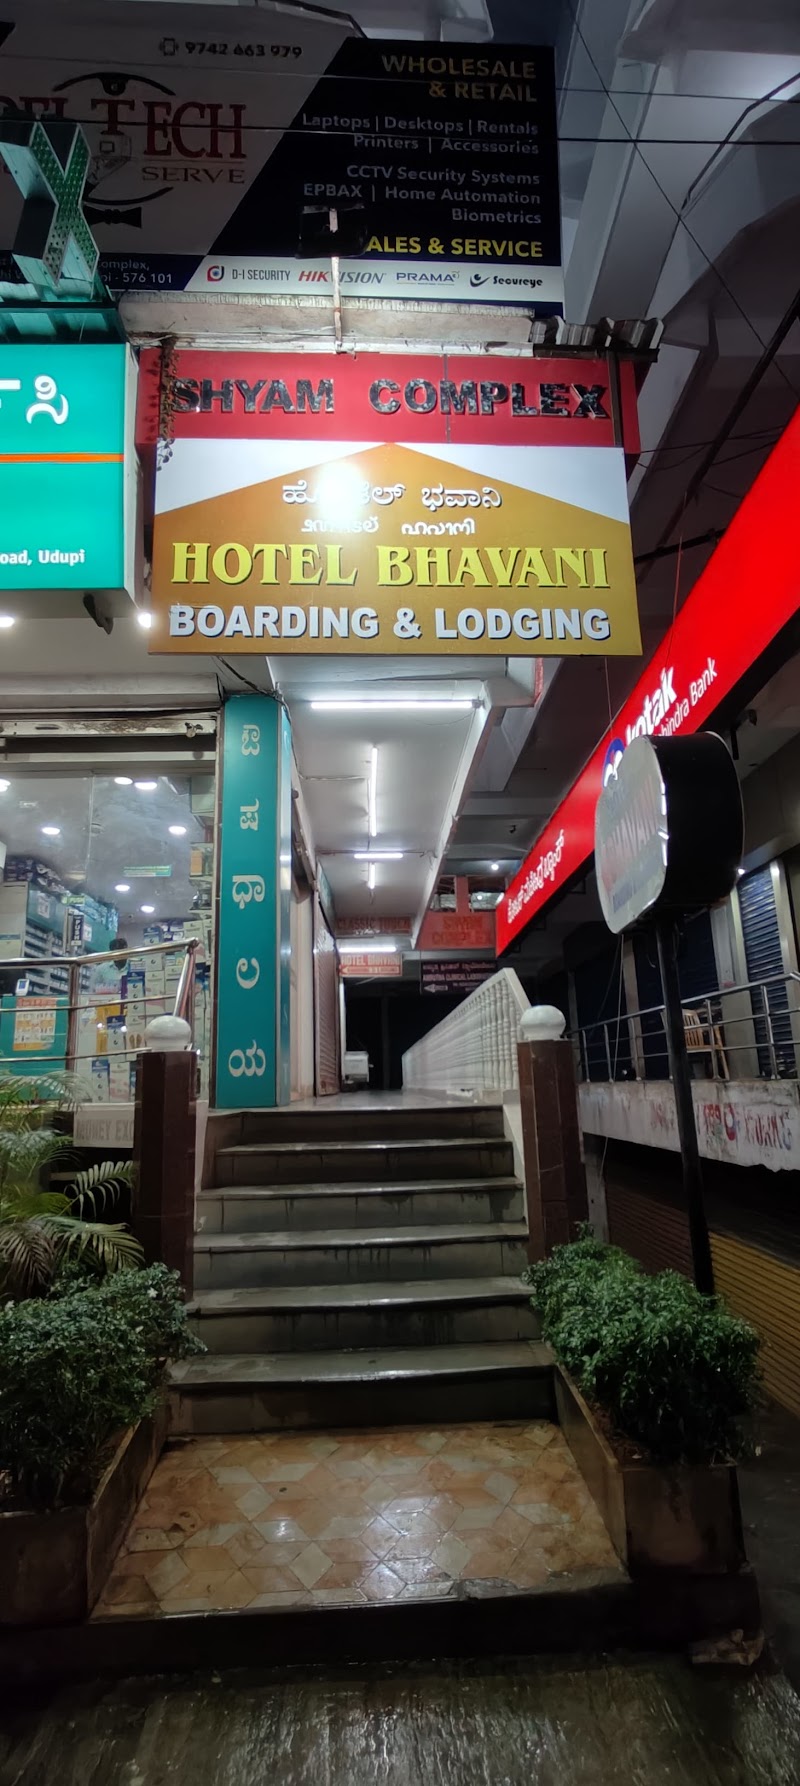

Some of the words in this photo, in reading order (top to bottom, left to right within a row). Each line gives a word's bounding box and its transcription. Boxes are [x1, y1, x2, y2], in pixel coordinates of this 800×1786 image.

[185, 42, 228, 55] 9742
[234, 44, 265, 57] 663
[271, 45, 302, 59] 979
[382, 54, 537, 79] WHOLESALE
[428, 81, 447, 98] &
[454, 83, 538, 103] RETAIL
[91, 98, 247, 159] TECH
[301, 114, 371, 134] Laptops
[384, 115, 464, 135] Desktops
[477, 119, 539, 136] Rentals
[353, 133, 420, 150] Printers
[440, 139, 540, 155] Accessories
[142, 166, 246, 184] SERVE
[346, 164, 394, 179] CCTV
[396, 166, 466, 186] Security
[471, 169, 541, 186] Systems
[303, 182, 363, 198] EPBAX
[385, 185, 437, 201] Home
[440, 187, 542, 206] Automation
[451, 208, 542, 225] Biometrics
[366, 235, 422, 254] ALES
[427, 236, 445, 255] &
[450, 237, 544, 258] SERVICE
[99, 259, 150, 271] omplex,
[232, 269, 246, 280] D-I
[248, 269, 291, 281] SECURITY
[122, 272, 146, 283] 576
[150, 273, 173, 284] 101
[396, 271, 455, 282] PRAMA
[172, 375, 335, 415] SHYAM
[369, 377, 610, 419] COMPLEX
[421, 482, 503, 512] ಭವಾನಿ
[0, 549, 33, 566] oad,
[38, 548, 86, 567] Udupi
[170, 541, 359, 586] HOTEL
[376, 545, 611, 589] BHAVANI
[168, 603, 379, 640] BOARDING
[393, 606, 422, 640] &
[434, 606, 611, 641] LODGING
[689, 657, 718, 708] Bank
